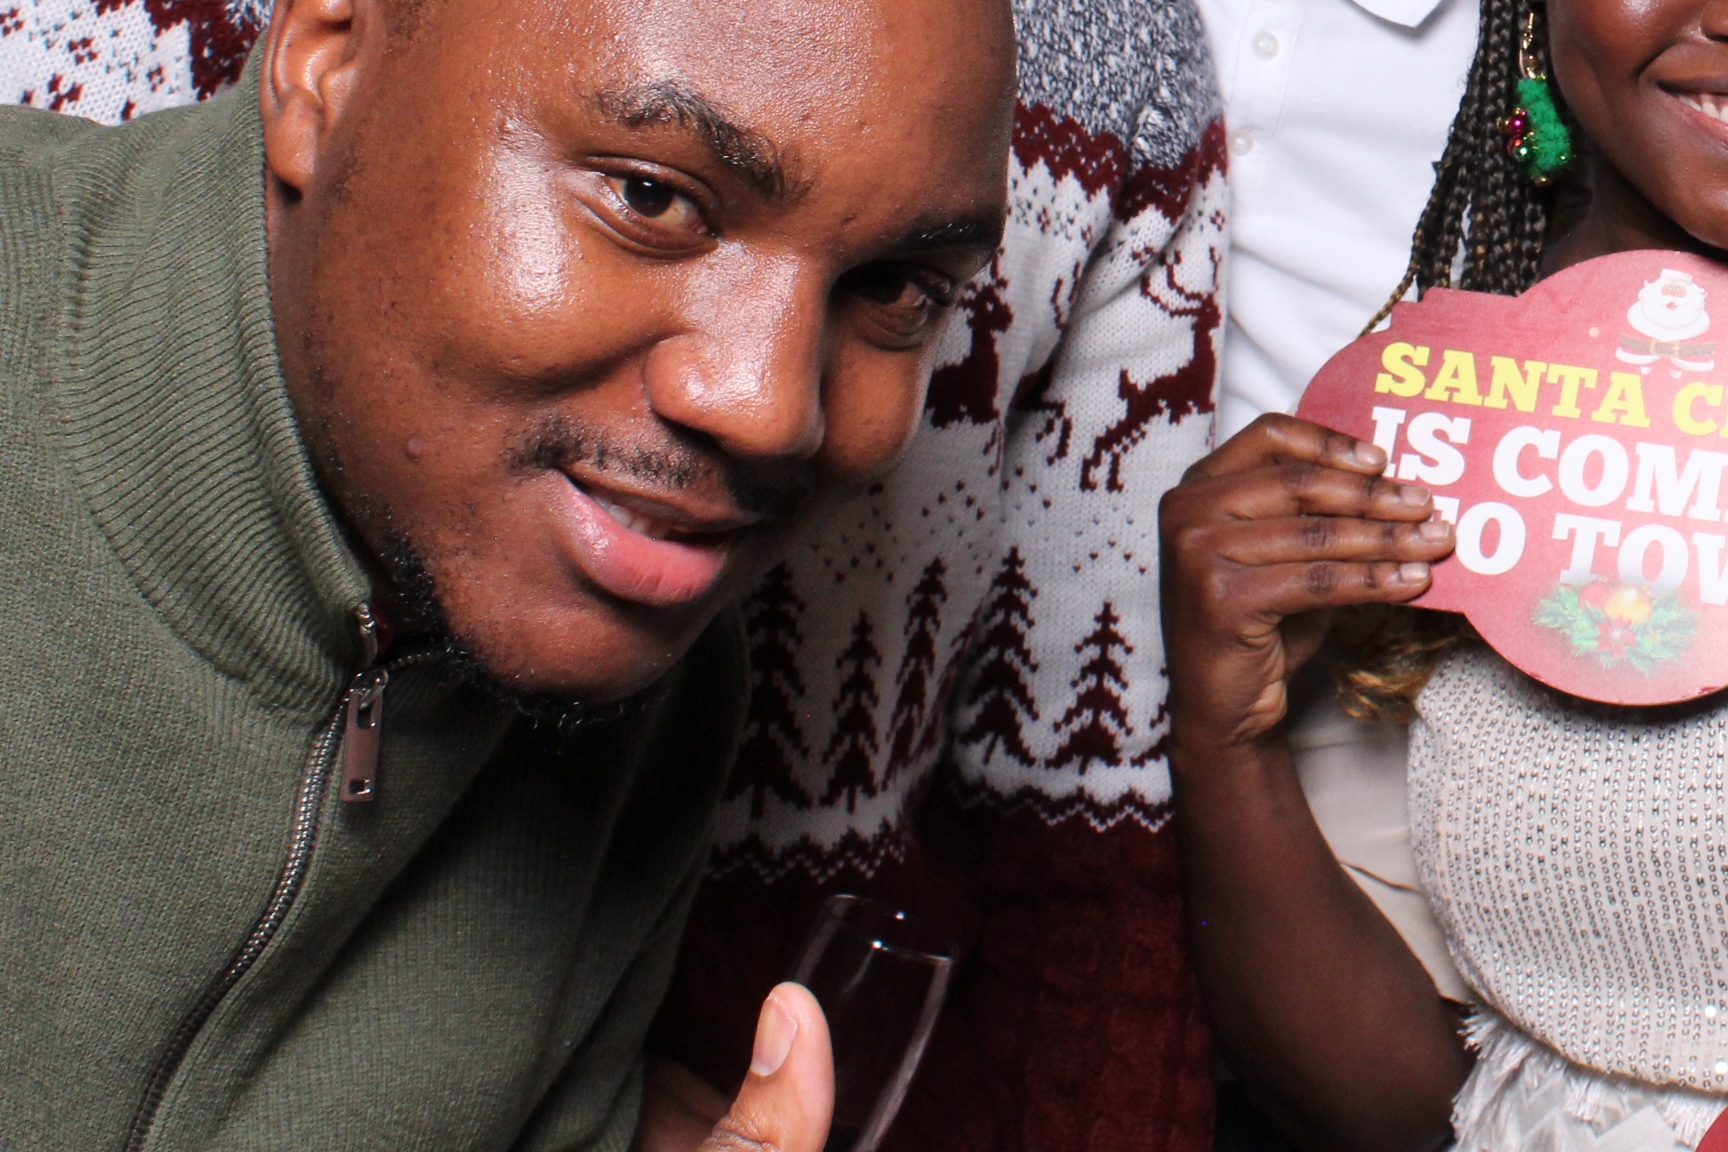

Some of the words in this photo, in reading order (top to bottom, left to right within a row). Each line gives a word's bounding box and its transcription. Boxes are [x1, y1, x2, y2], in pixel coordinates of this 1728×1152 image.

[1376, 342, 1650, 427] SANTA
[1371, 406, 1472, 486] IS
[1430, 495, 1526, 575] O
